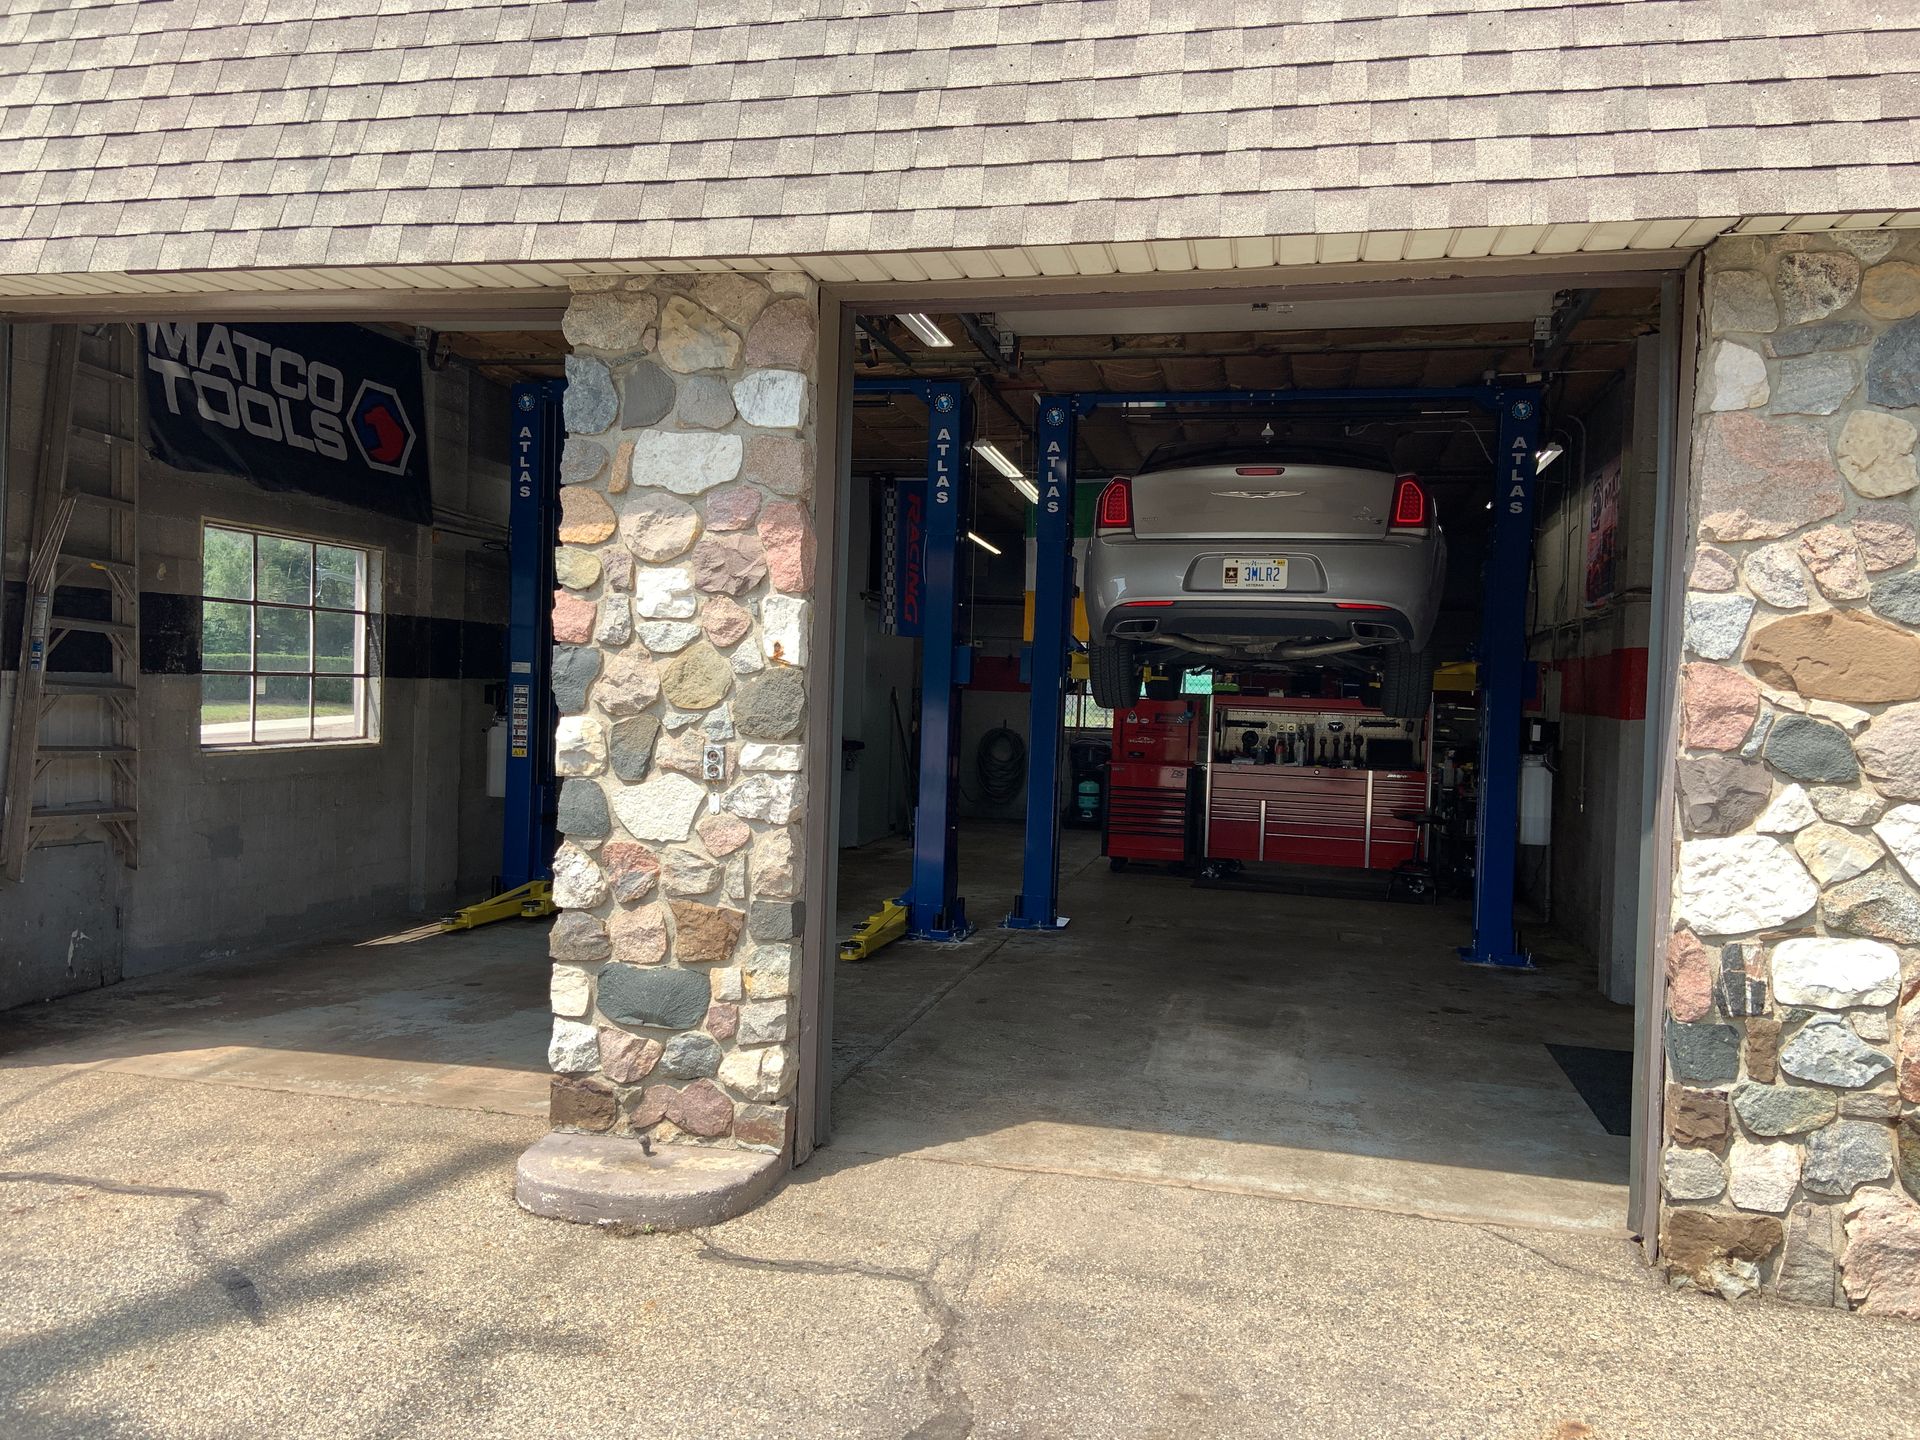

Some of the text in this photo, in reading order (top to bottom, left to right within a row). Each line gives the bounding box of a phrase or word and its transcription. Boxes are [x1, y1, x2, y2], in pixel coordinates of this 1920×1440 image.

[144, 322, 344, 413] MATCO
[148, 353, 348, 461] TOOLS
[519, 426, 532, 498] ATLAS
[936, 428, 951, 504] ATLAS
[1047, 441, 1060, 513] ATLAS
[1509, 436, 1527, 514] ATLAS
[904, 493, 923, 625] RACING
[1244, 566, 1280, 582] 3MLR2
